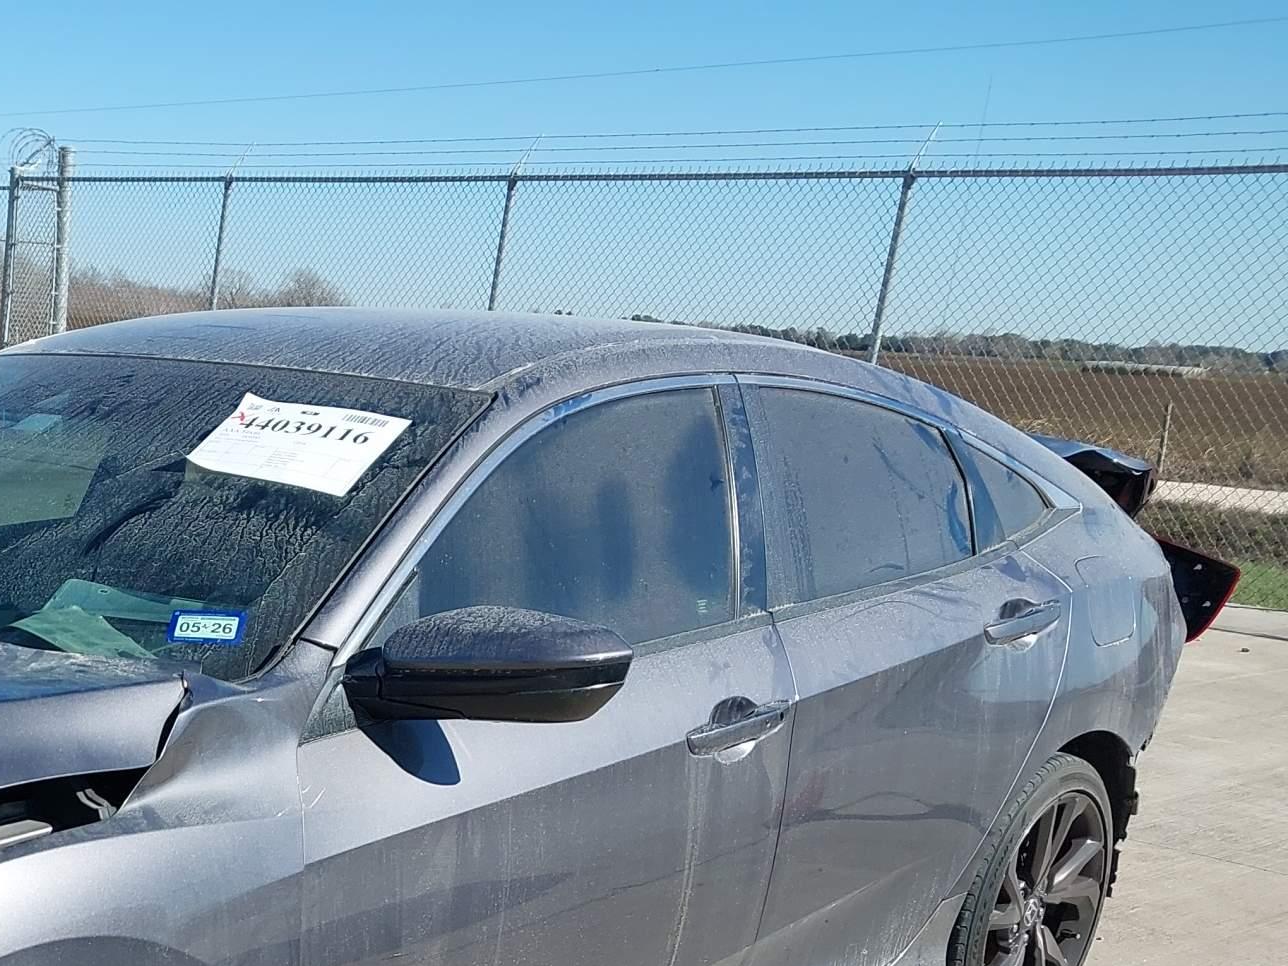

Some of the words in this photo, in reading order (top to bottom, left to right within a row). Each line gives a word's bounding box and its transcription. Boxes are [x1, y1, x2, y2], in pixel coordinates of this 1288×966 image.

[239, 416, 375, 445] 44039116
[179, 622, 201, 633] 05
[211, 623, 233, 634] 26
